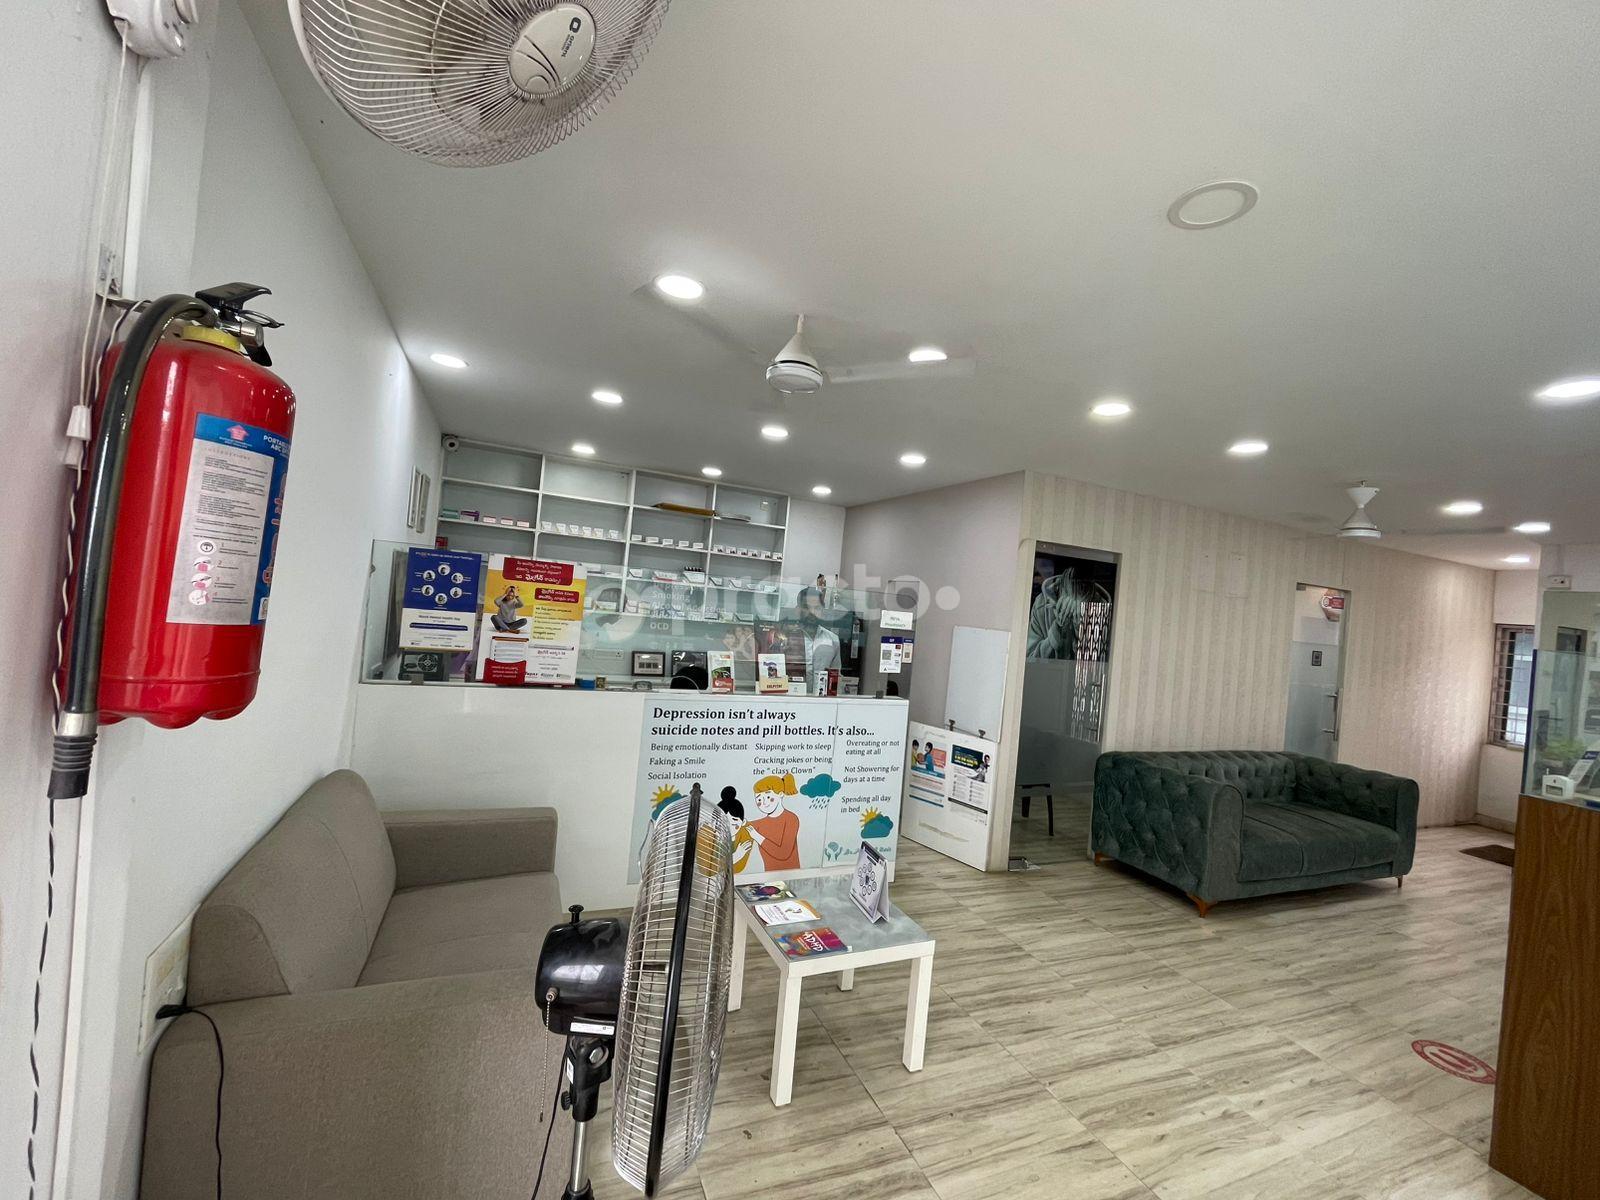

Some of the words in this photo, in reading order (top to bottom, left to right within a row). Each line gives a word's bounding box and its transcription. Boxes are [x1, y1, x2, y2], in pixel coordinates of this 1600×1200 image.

[650, 622, 670, 630] OCD
[653, 708, 724, 720] Depression
[728, 708, 754, 719] isn't
[757, 709, 796, 722] always
[651, 725, 698, 735] suicide
[701, 726, 734, 735] notes
[738, 725, 759, 735] and
[763, 726, 781, 738] pill
[784, 726, 824, 735] bottles.
[828, 726, 843, 735] It's
[846, 726, 874, 735] also...
[651, 743, 673, 752] Being
[675, 743, 720, 752] emotionally
[755, 743, 785, 751] Skipping
[814, 742, 831, 751] sleep
[649, 757, 676, 767] Faking
[754, 757, 784, 765] Cracking
[842, 796, 870, 804] Spending
